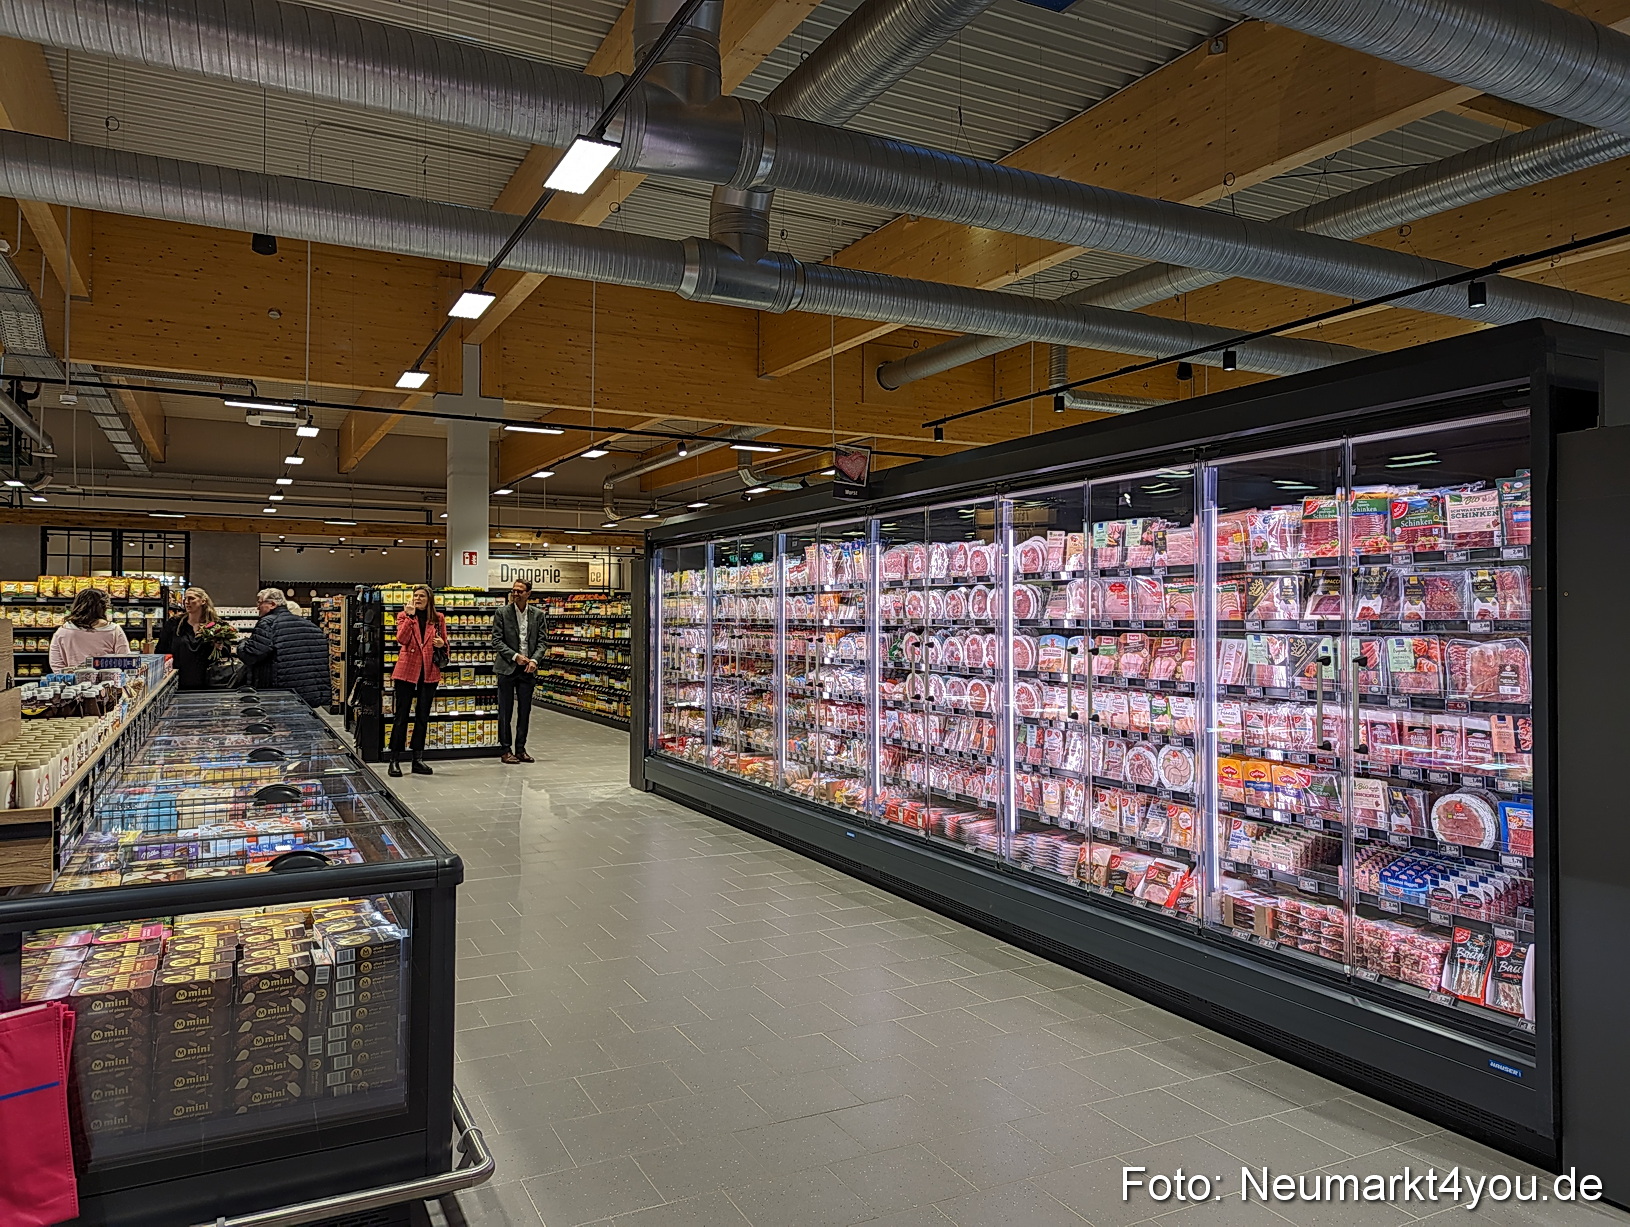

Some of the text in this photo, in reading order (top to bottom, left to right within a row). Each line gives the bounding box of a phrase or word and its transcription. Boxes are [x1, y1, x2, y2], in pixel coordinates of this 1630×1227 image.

[1464, 496, 1480, 504] Bio
[1451, 510, 1499, 519] SCHINKEN
[500, 564, 560, 583] Drogerie
[1441, 736, 1455, 744] LAND
[1457, 947, 1485, 960] Bacon
[1499, 961, 1523, 973] Baco
[271, 976, 292, 986] mini
[189, 987, 211, 997] mini
[105, 998, 128, 1008] mini
[268, 1004, 289, 1014] mini
[187, 1016, 210, 1026] mini
[104, 1027, 128, 1037] mini
[265, 1033, 286, 1042] mini
[188, 1044, 210, 1054] mini
[105, 1057, 129, 1067] mini
[265, 1061, 286, 1071] mini
[186, 1073, 209, 1083] mini
[105, 1086, 128, 1096] mini
[263, 1089, 285, 1099] mini
[186, 1102, 208, 1112] mini
[104, 1116, 127, 1126] mini
